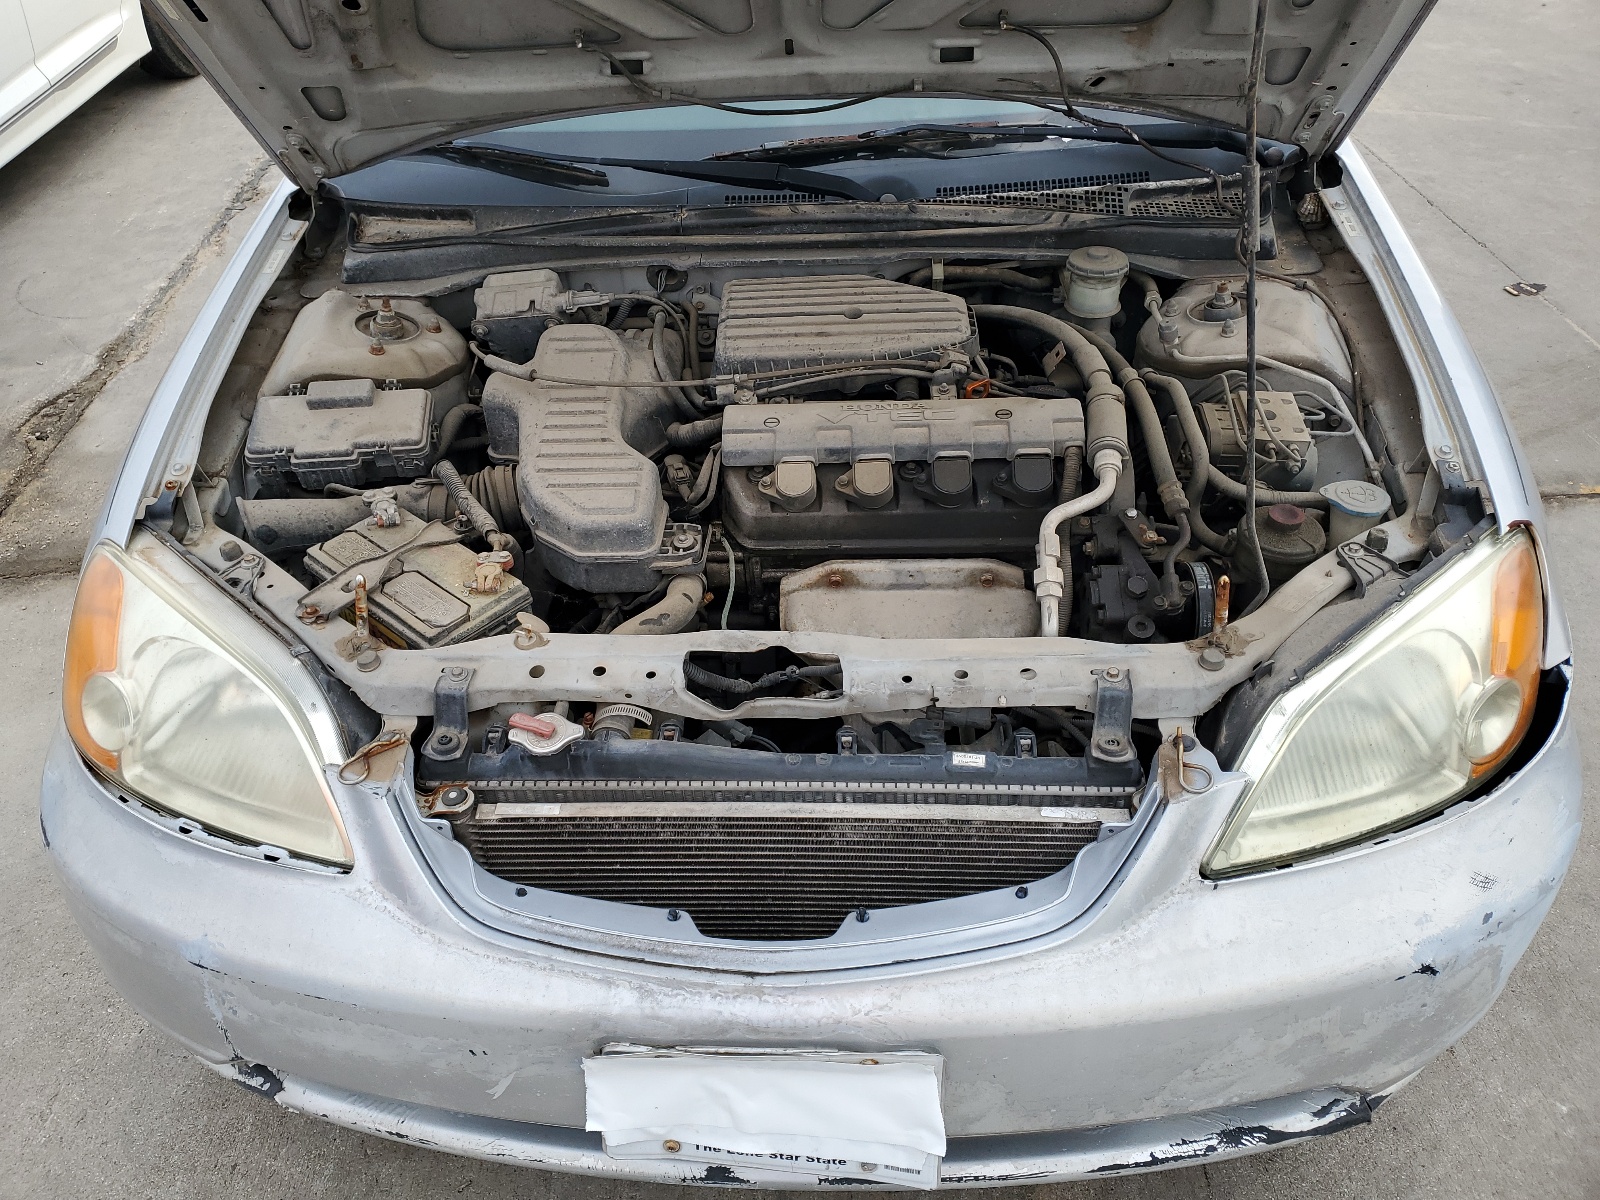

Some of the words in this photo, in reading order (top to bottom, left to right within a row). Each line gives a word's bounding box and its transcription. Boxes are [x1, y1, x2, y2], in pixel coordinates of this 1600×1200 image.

[841, 402, 932, 411] HONDA
[817, 411, 956, 424] VTEC
[768, 1152, 801, 1162] Star
[805, 1155, 847, 1166] State
